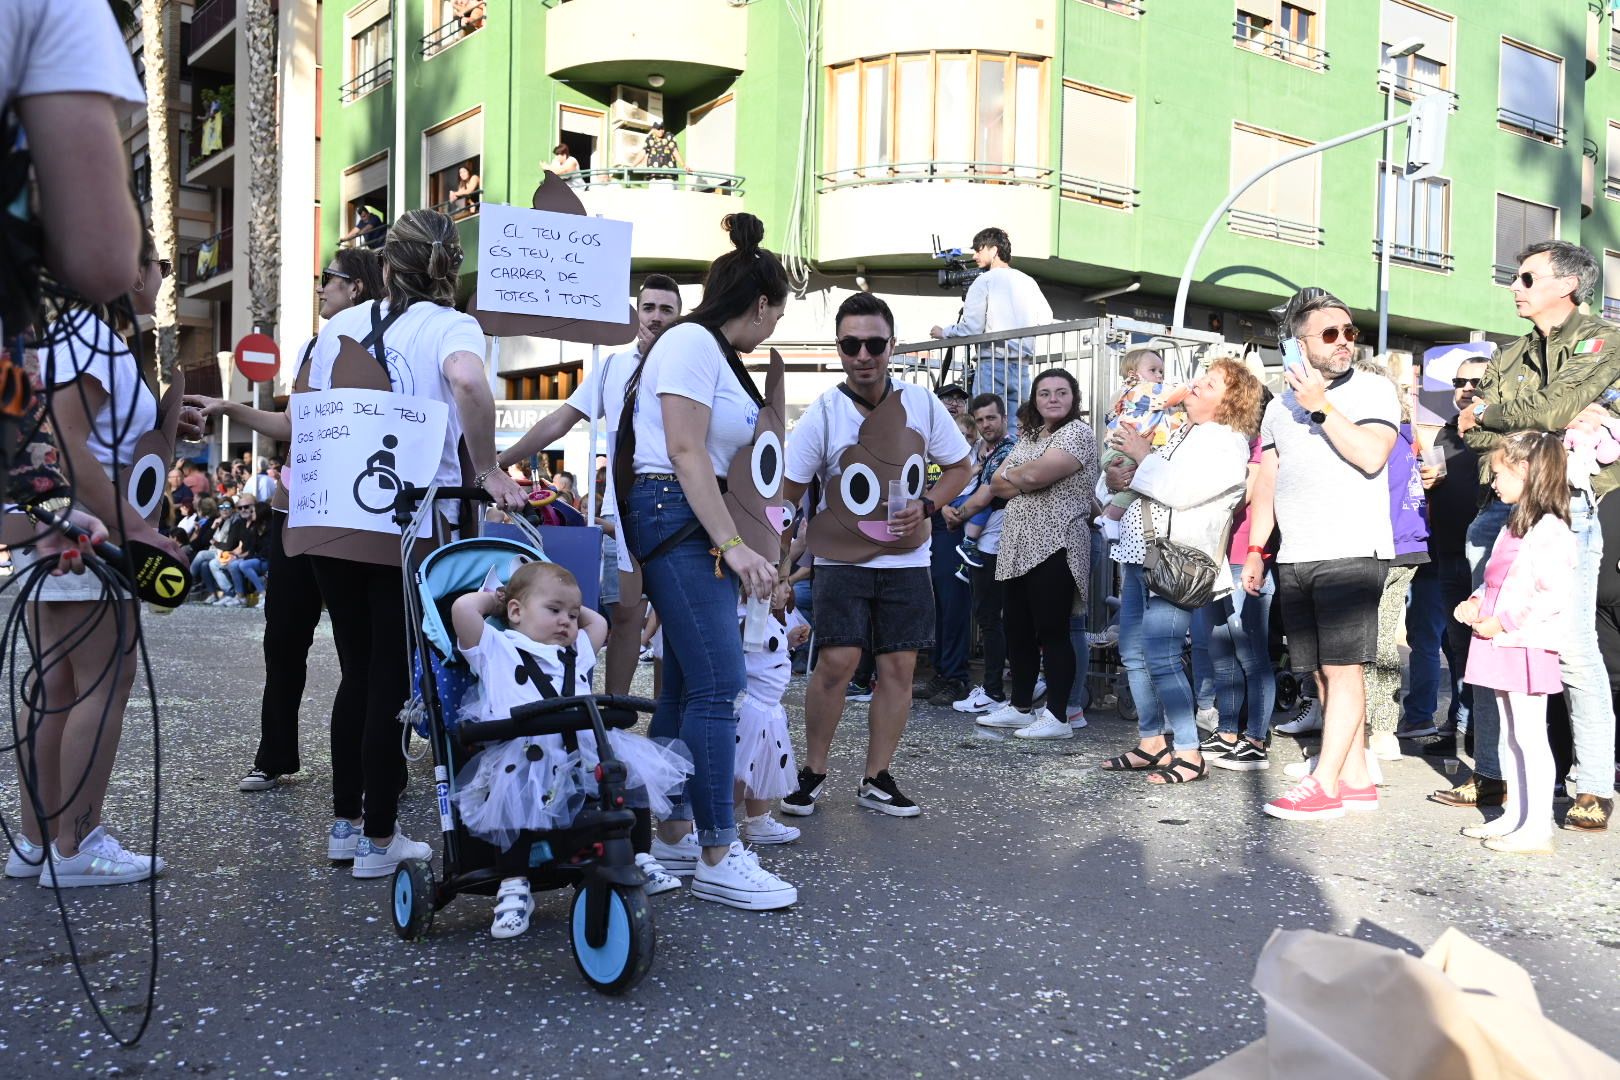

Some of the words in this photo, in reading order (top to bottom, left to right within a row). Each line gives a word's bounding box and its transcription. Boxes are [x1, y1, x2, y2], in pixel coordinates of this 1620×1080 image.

[503, 223, 524, 239] EL
[532, 227, 561, 241] TEU
[568, 230, 601, 247] GOS
[518, 247, 554, 263] TEU,
[561, 252, 585, 264] EL
[490, 267, 546, 282] CARRER
[558, 271, 580, 284] DE
[495, 289, 539, 303] TOTES
[559, 293, 602, 308] TOTS
[298, 404, 311, 420] LA
[315, 401, 344, 419] MERDA
[353, 402, 385, 416] DEL
[393, 407, 426, 423] TEU
[297, 432, 314, 444] GOS
[318, 425, 351, 440] ACABA
[310, 448, 322, 461] LES
